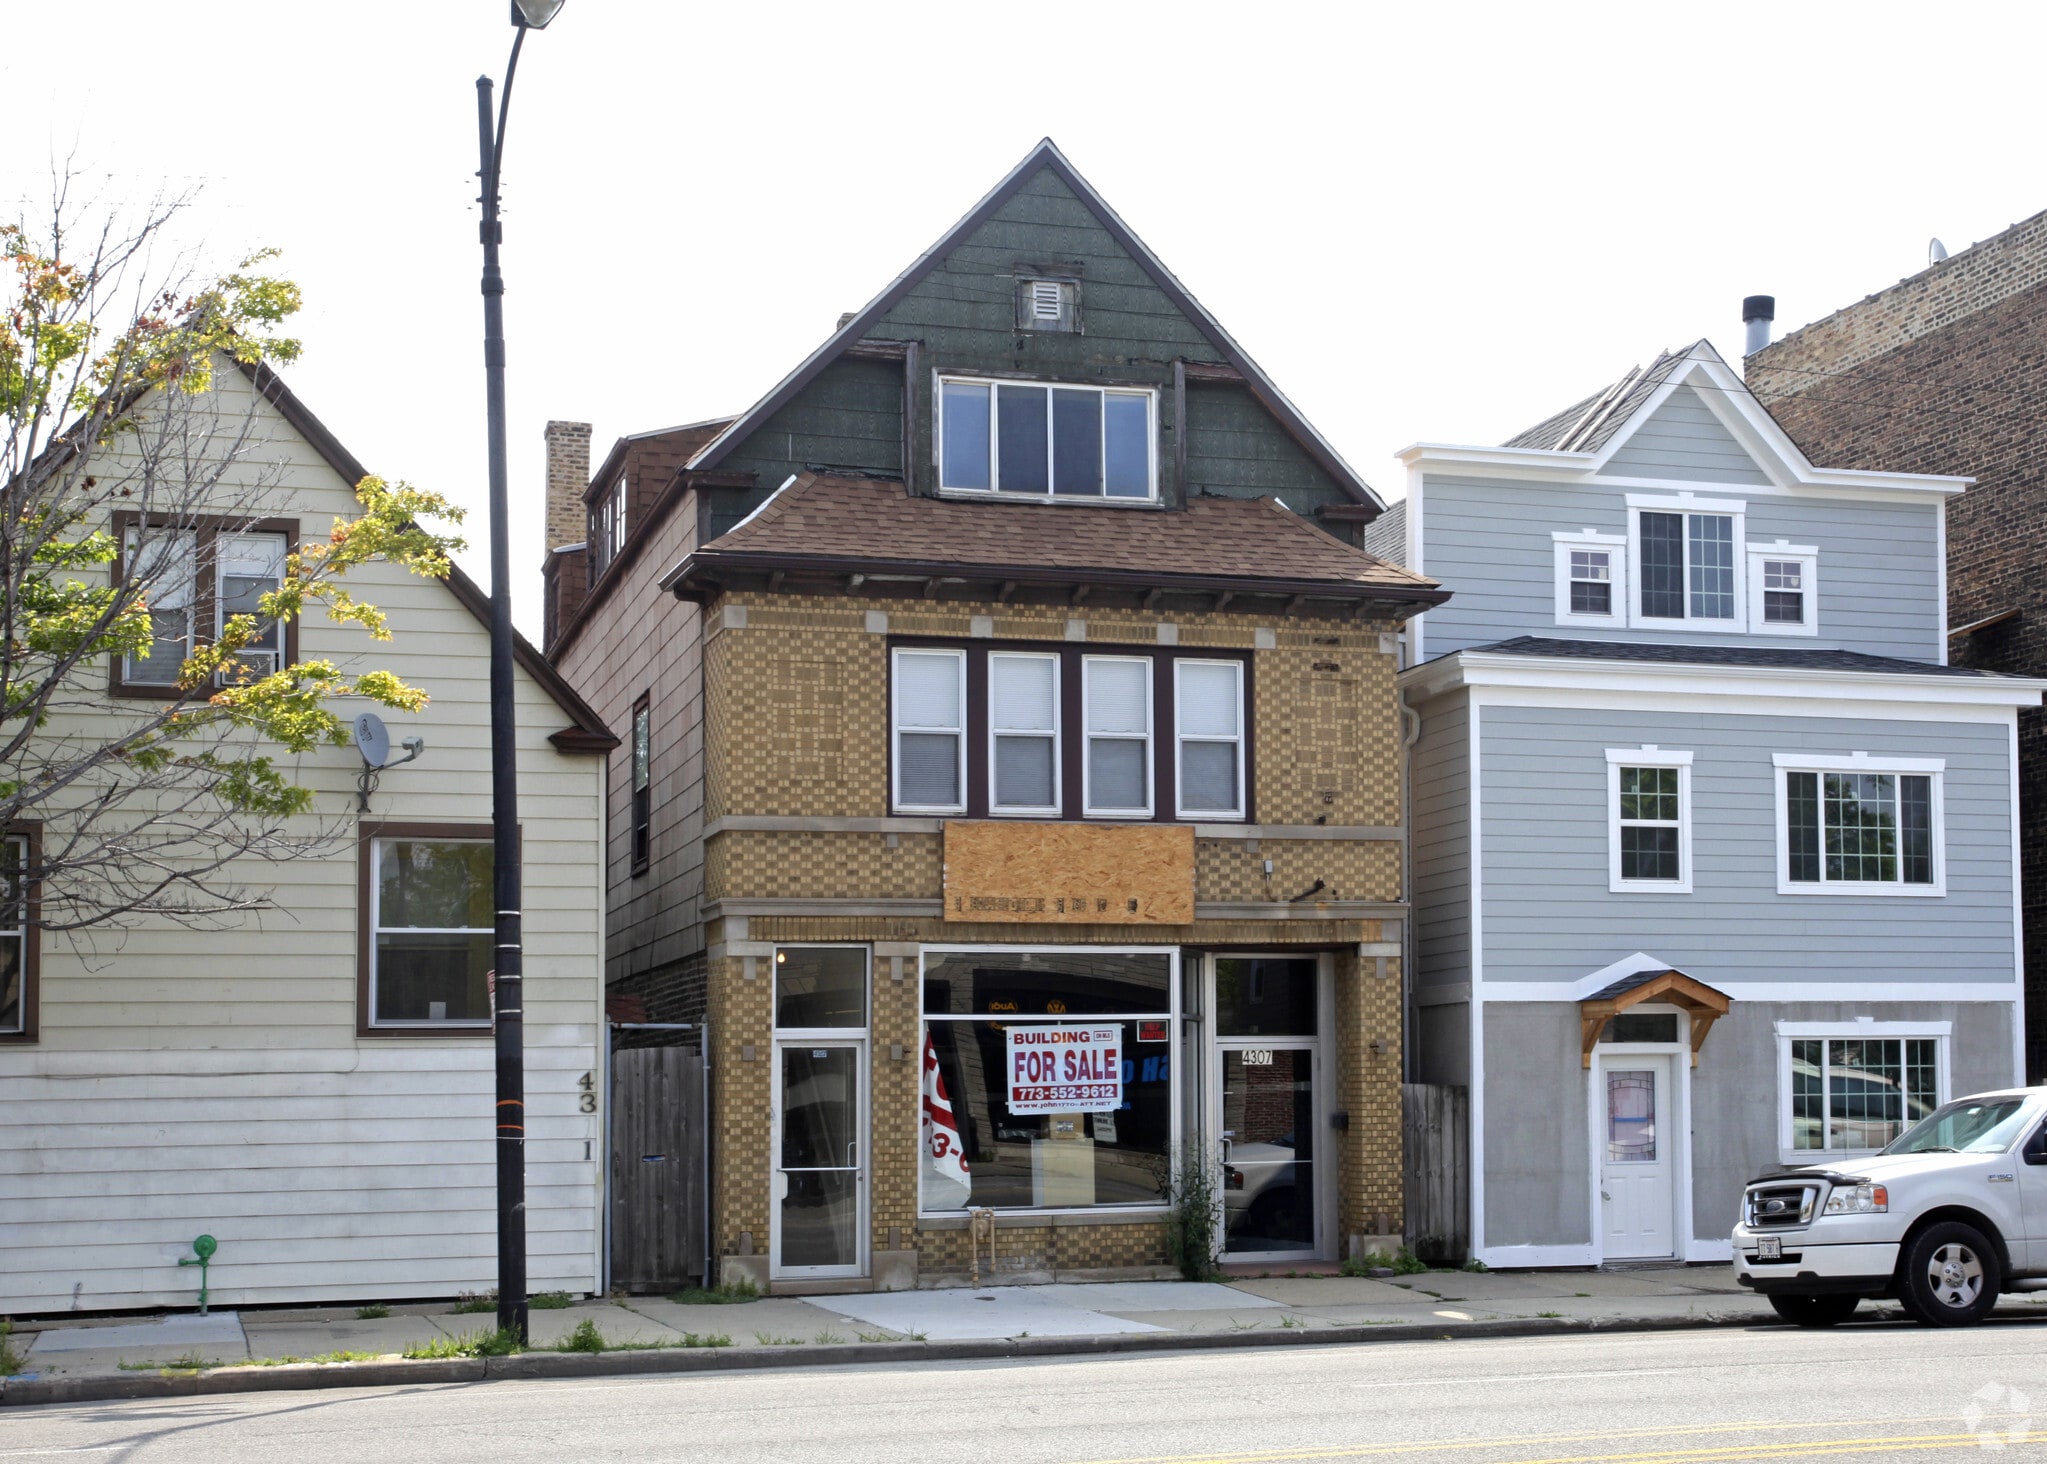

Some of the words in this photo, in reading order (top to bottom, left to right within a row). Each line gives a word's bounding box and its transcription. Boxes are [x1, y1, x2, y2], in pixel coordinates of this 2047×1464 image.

[1013, 1031, 1090, 1045] BUILDING
[1242, 1050, 1271, 1064] 4307
[1014, 1051, 1056, 1083] FOR
[1064, 1049, 1117, 1082] SALE
[1018, 1085, 1114, 1100] 773-552-9612
